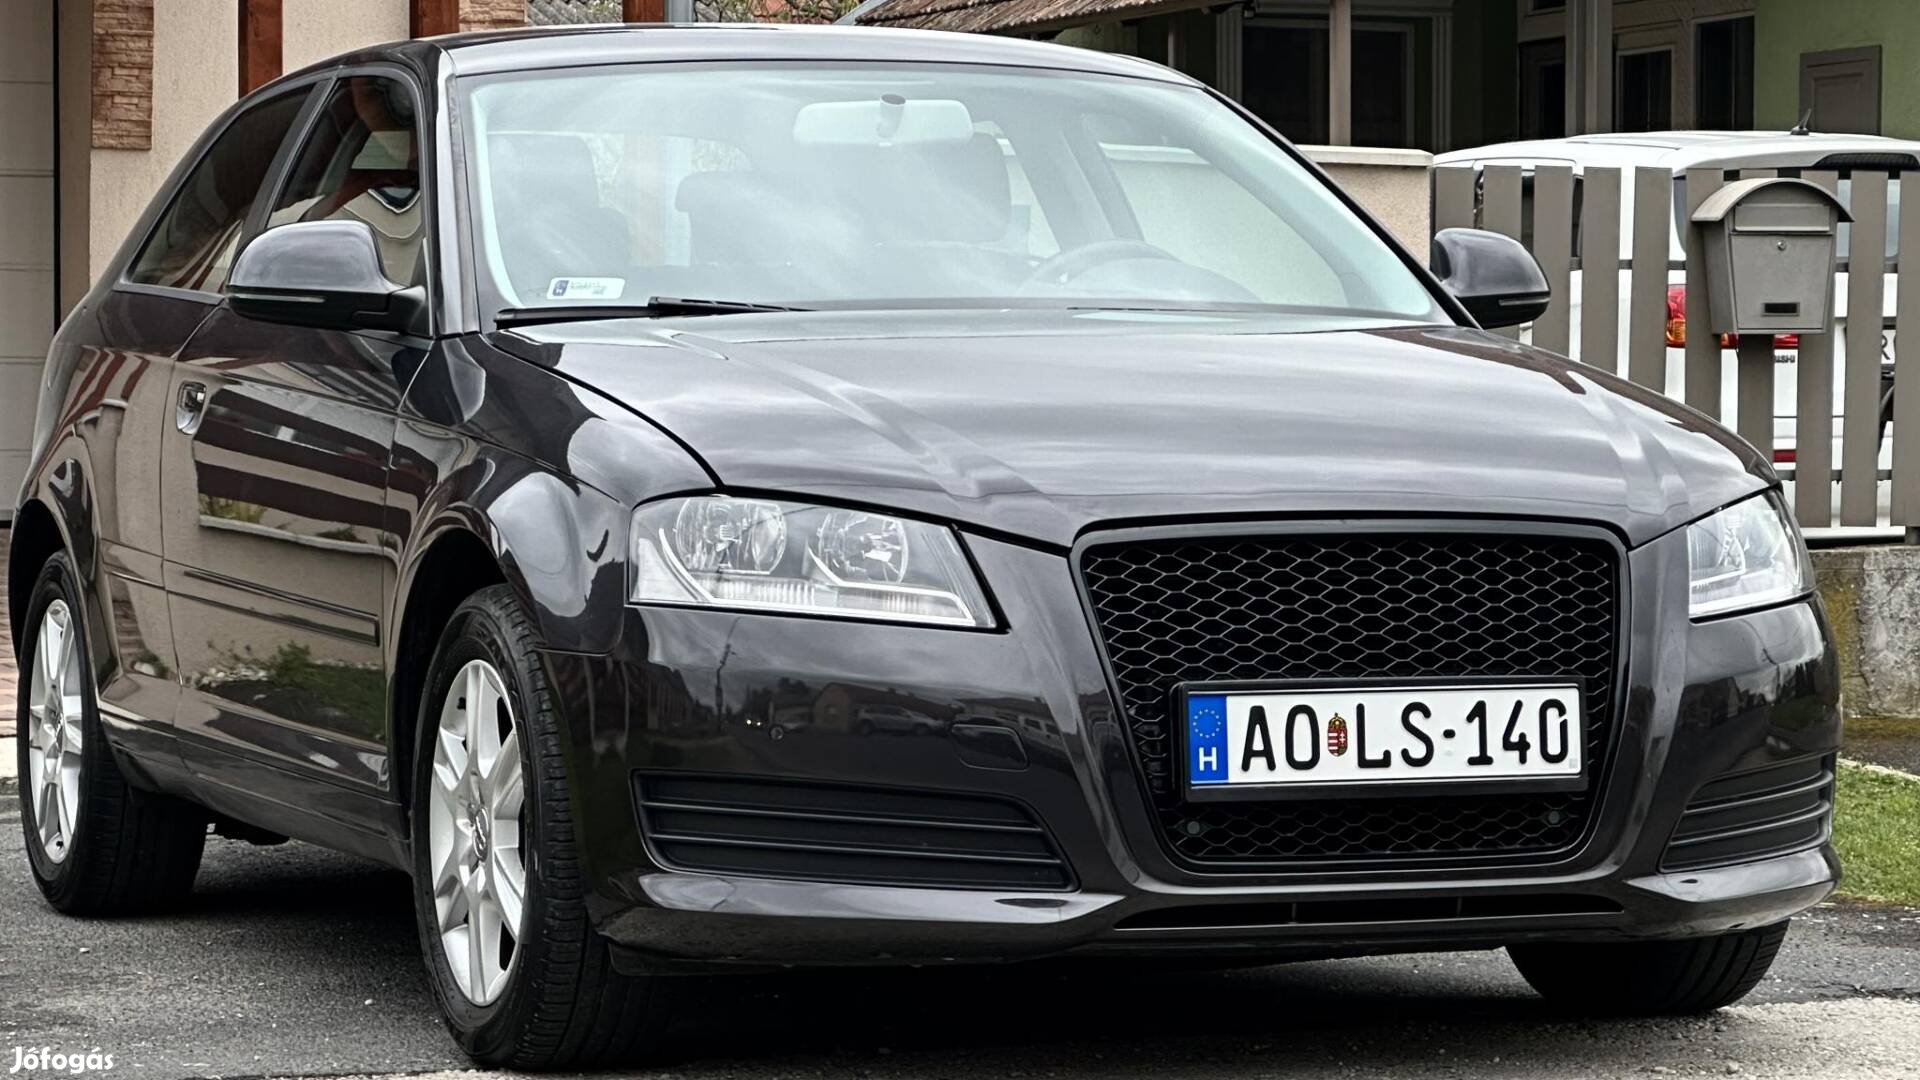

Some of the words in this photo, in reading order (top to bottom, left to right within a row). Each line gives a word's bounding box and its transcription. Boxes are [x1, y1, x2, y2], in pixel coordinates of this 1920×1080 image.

[1198, 747, 1218, 771] H
[1241, 704, 1321, 772] AO
[1356, 698, 1569, 769] LS-140
